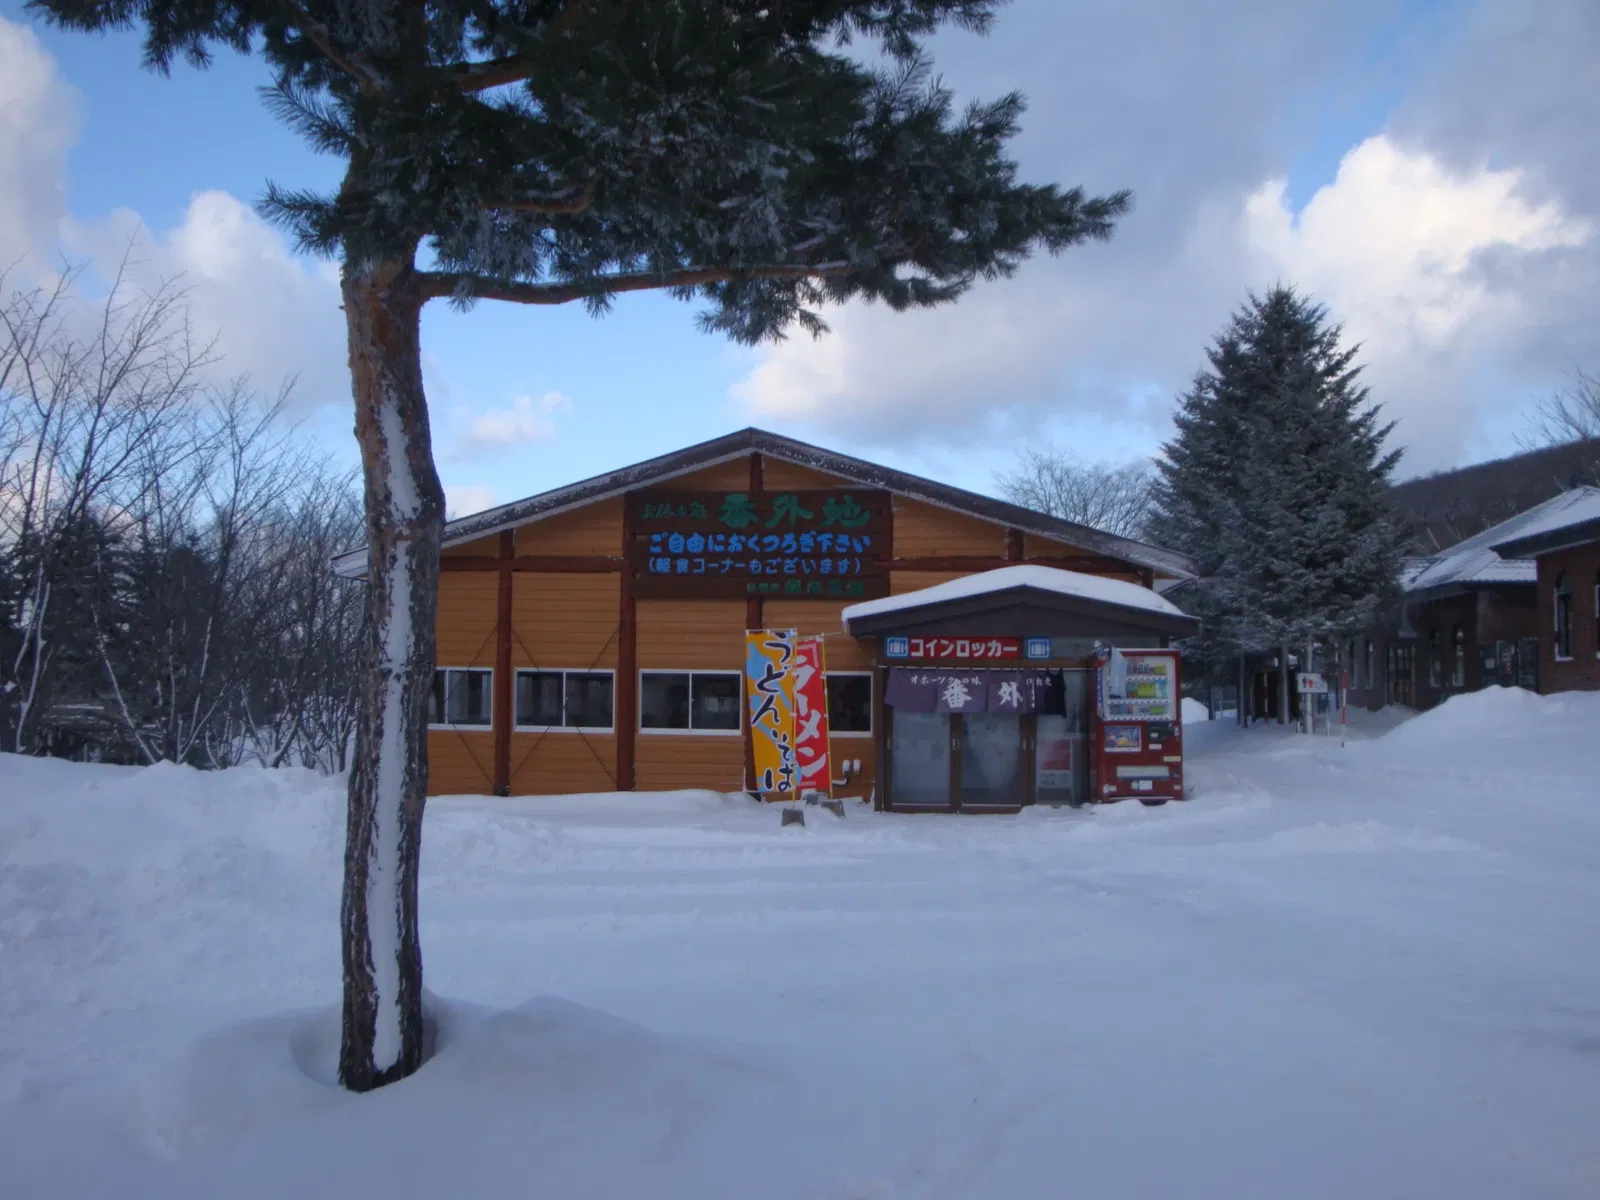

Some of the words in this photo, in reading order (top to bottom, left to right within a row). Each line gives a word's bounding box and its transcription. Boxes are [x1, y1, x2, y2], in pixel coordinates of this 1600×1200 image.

[719, 493, 870, 528] 番外地
[649, 531, 871, 554] ご自由におくつろぎ下さい
[910, 639, 1018, 658] コインロッカー
[910, 675, 982, 686] オホーツクの味
[942, 679, 1035, 709] 番外
[794, 654, 827, 778] ラーメン
